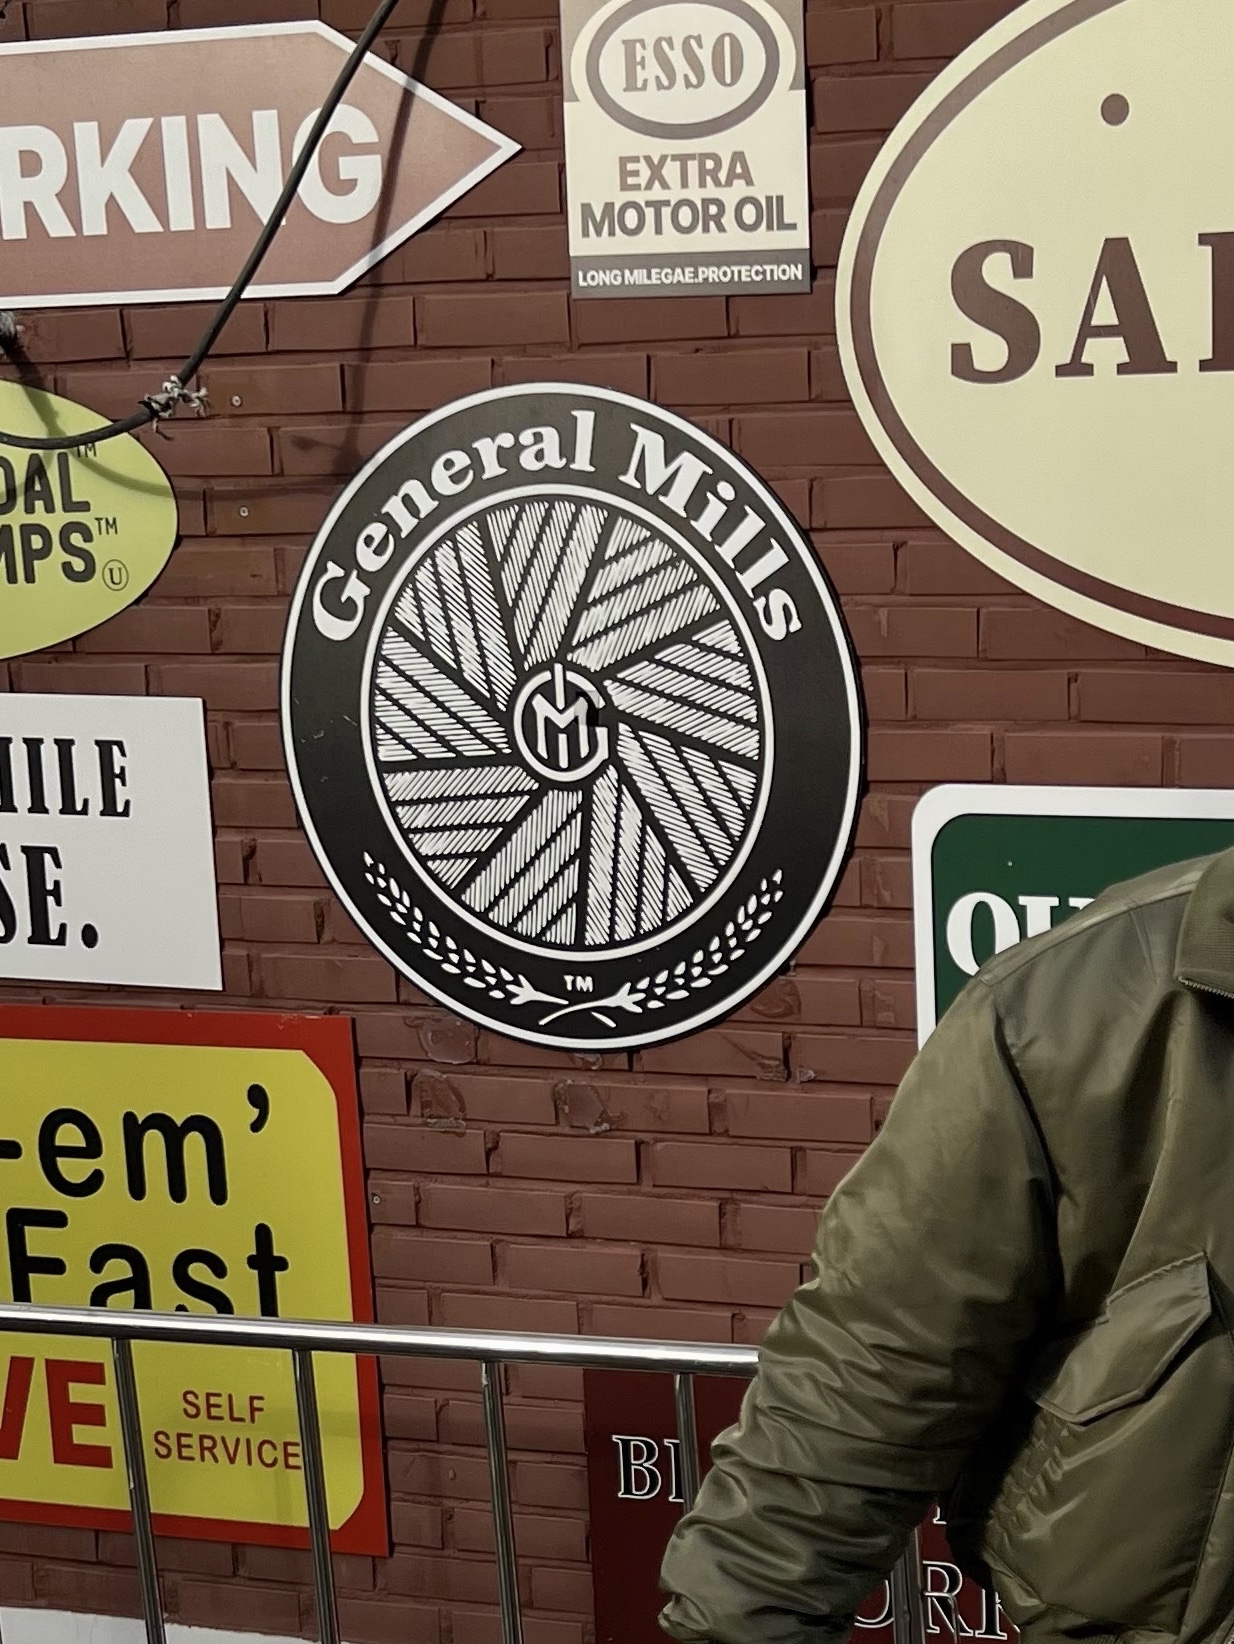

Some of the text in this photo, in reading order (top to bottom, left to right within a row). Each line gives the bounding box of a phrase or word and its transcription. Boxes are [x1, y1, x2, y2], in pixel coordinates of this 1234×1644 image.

[621, 31, 745, 93] ESSO
[0, 103, 383, 241] RKING
[618, 150, 756, 192] EXTRA
[579, 195, 798, 238] MOTOR OIL
[577, 269, 622, 287] LONG
[311, 409, 803, 643] General Mills
[563, 974, 594, 993] TM
[6, 1207, 290, 1319] Fast
[182, 1389, 266, 1424] SELF
[153, 1430, 303, 1471] SERVICE
